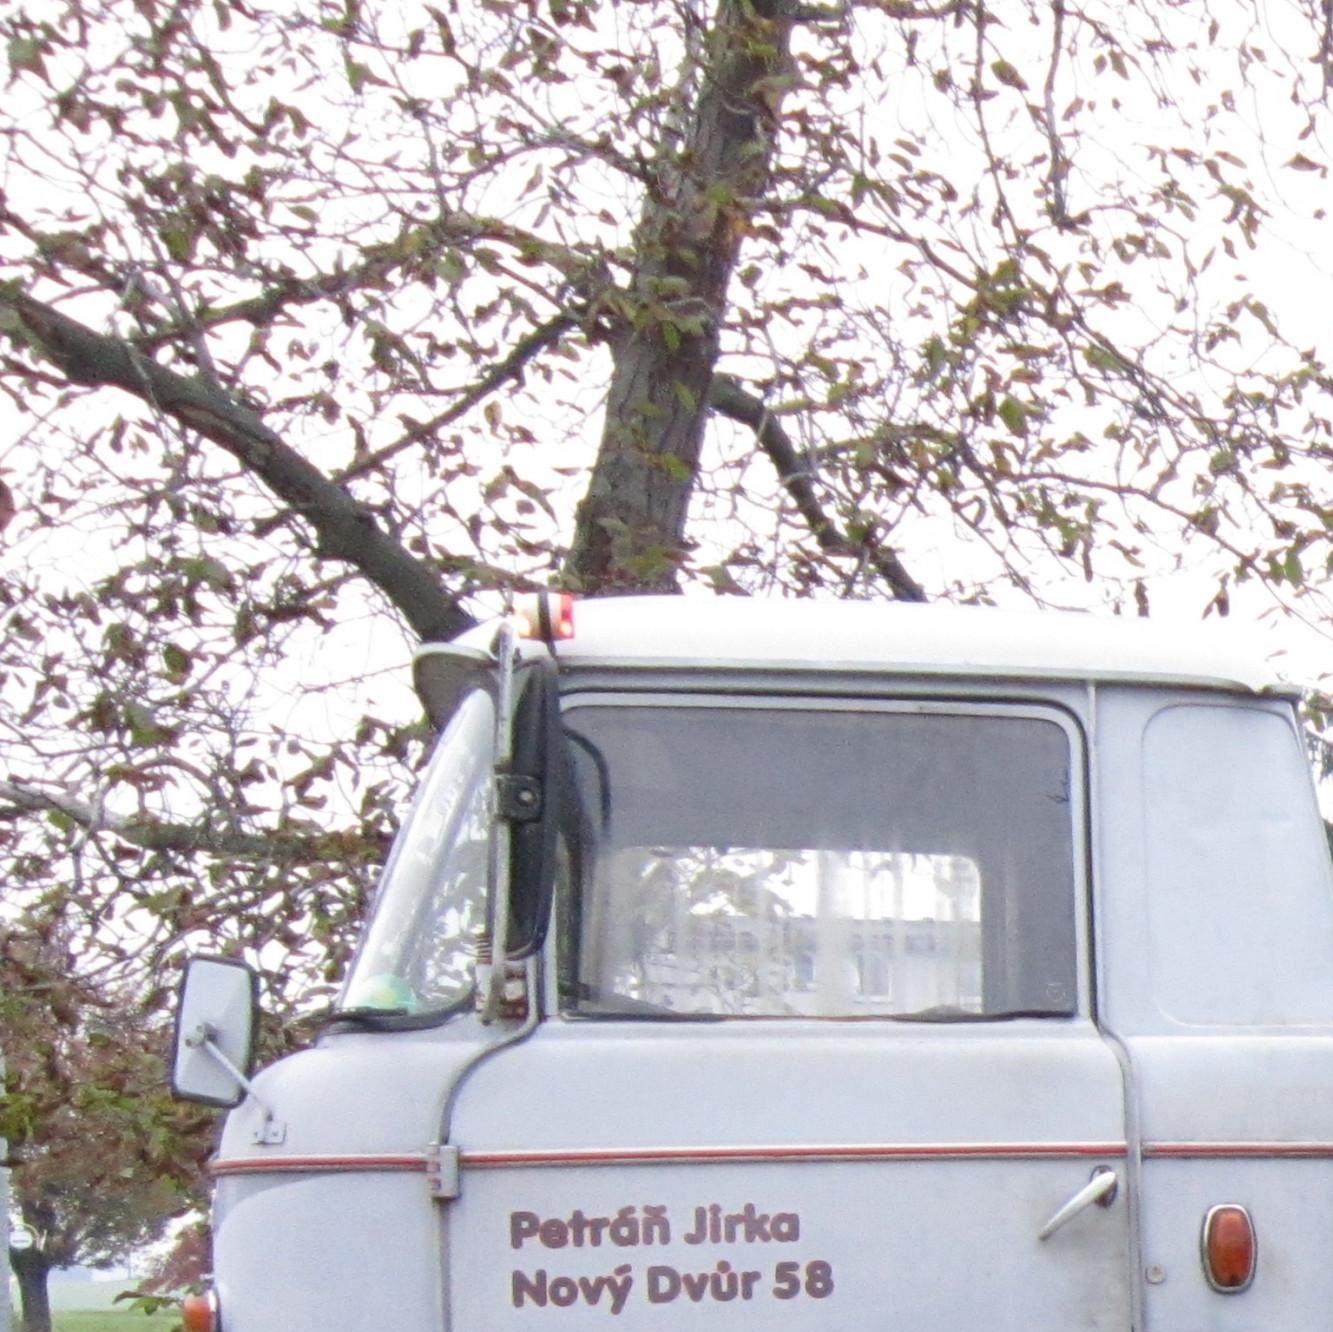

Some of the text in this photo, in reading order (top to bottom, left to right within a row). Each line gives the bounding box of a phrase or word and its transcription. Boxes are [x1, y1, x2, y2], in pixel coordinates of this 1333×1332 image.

[510, 1203, 801, 1249] Petráň Jirka
[511, 1260, 835, 1315] Nový Dvůr 58
